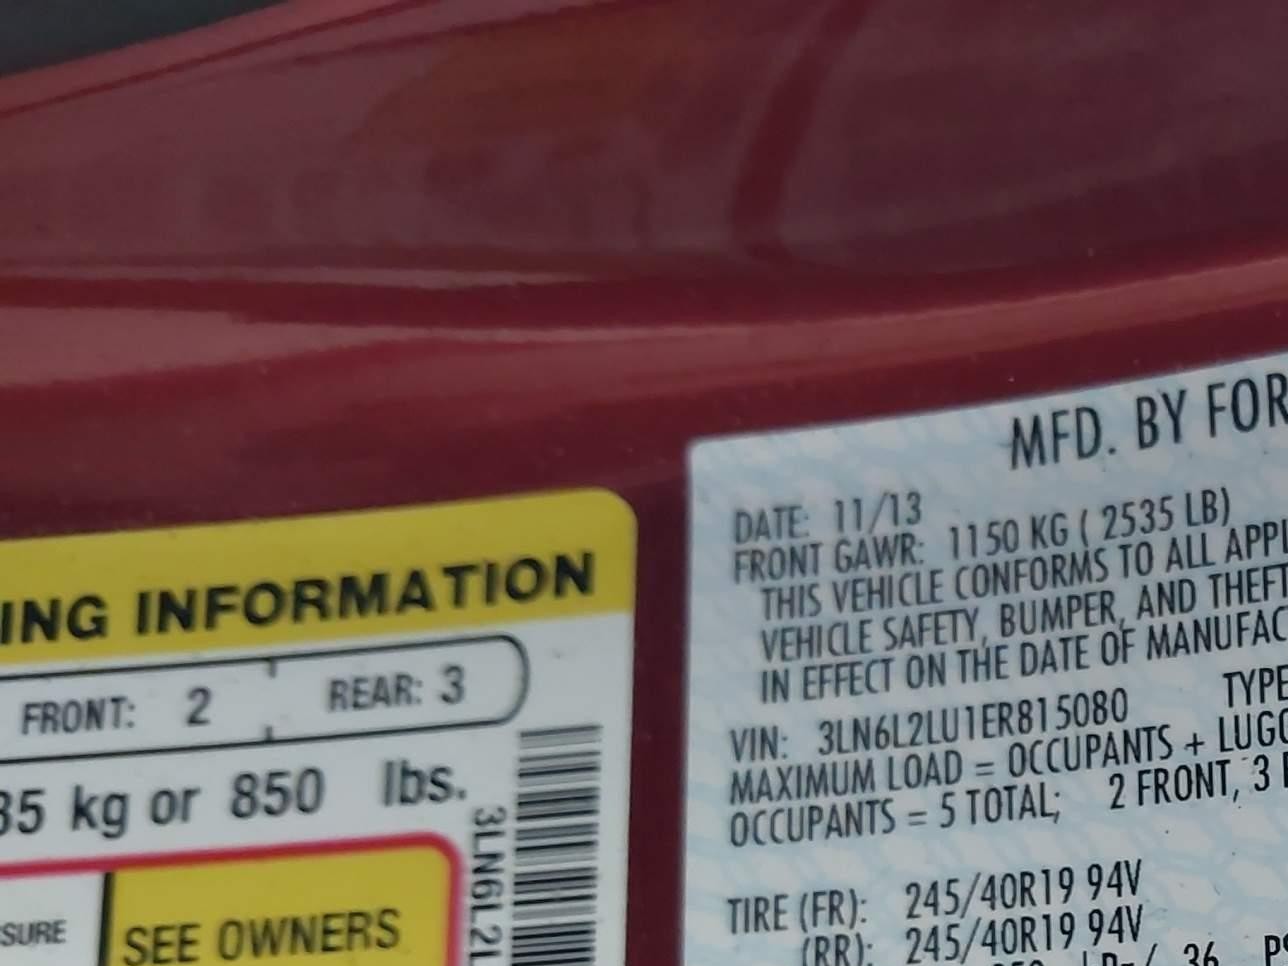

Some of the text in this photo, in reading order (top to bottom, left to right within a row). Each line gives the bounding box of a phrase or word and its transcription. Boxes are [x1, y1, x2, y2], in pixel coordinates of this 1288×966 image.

[1010, 405, 1116, 470] MFD.
[1136, 388, 1187, 450] BY
[733, 491, 922, 545] DATE: 11/13
[733, 541, 822, 584] FRONT
[834, 532, 924, 574] GAWR:
[948, 519, 1019, 561] 1150
[1031, 511, 1069, 549] KG
[1103, 495, 1175, 540] 2535
[1185, 487, 1231, 526] LB)
[135, 552, 596, 635] INFORMATION
[761, 584, 822, 621] THIS
[832, 569, 943, 613] VEHICLE
[954, 547, 1109, 600] CONFORMS
[1120, 542, 1153, 578] TO
[1166, 533, 1215, 572] ALL
[761, 619, 873, 663] VEHICLE
[883, 607, 987, 651] SAFETY,
[1000, 589, 1125, 639] BUMPER,
[1136, 578, 1197, 617] AND
[21, 666, 466, 736] FRONT: 2 REAR: 3
[761, 669, 791, 700] IN
[803, 659, 893, 697] EFFECT
[906, 652, 948, 689] ON
[958, 645, 1009, 681] THE
[1019, 635, 1090, 676] DATE
[1100, 628, 1135, 666] OF
[729, 687, 1130, 764] VIN: 3LN6L2LU1ER815080
[730, 759, 876, 804] MAXIMUM
[887, 749, 963, 791] LOAD
[1007, 724, 1174, 778] OCCUPANTS
[70, 784, 127, 840] kg
[150, 786, 201, 826] or
[230, 767, 326, 818] 850
[382, 759, 467, 807] lbs.
[730, 799, 897, 847] OCCUPANTS
[939, 795, 957, 829] 5
[967, 782, 1062, 826] TOTAL;
[1109, 774, 1126, 810] 2
[1137, 759, 1238, 806] FRONT,
[1253, 753, 1270, 792] 3
[727, 858, 1143, 933] TIRE (FR): 245/40R19 94V
[905, 910, 1076, 965] 245/40R19
[1086, 904, 1144, 946] 94V
[123, 908, 401, 966] SEE OWNERS
